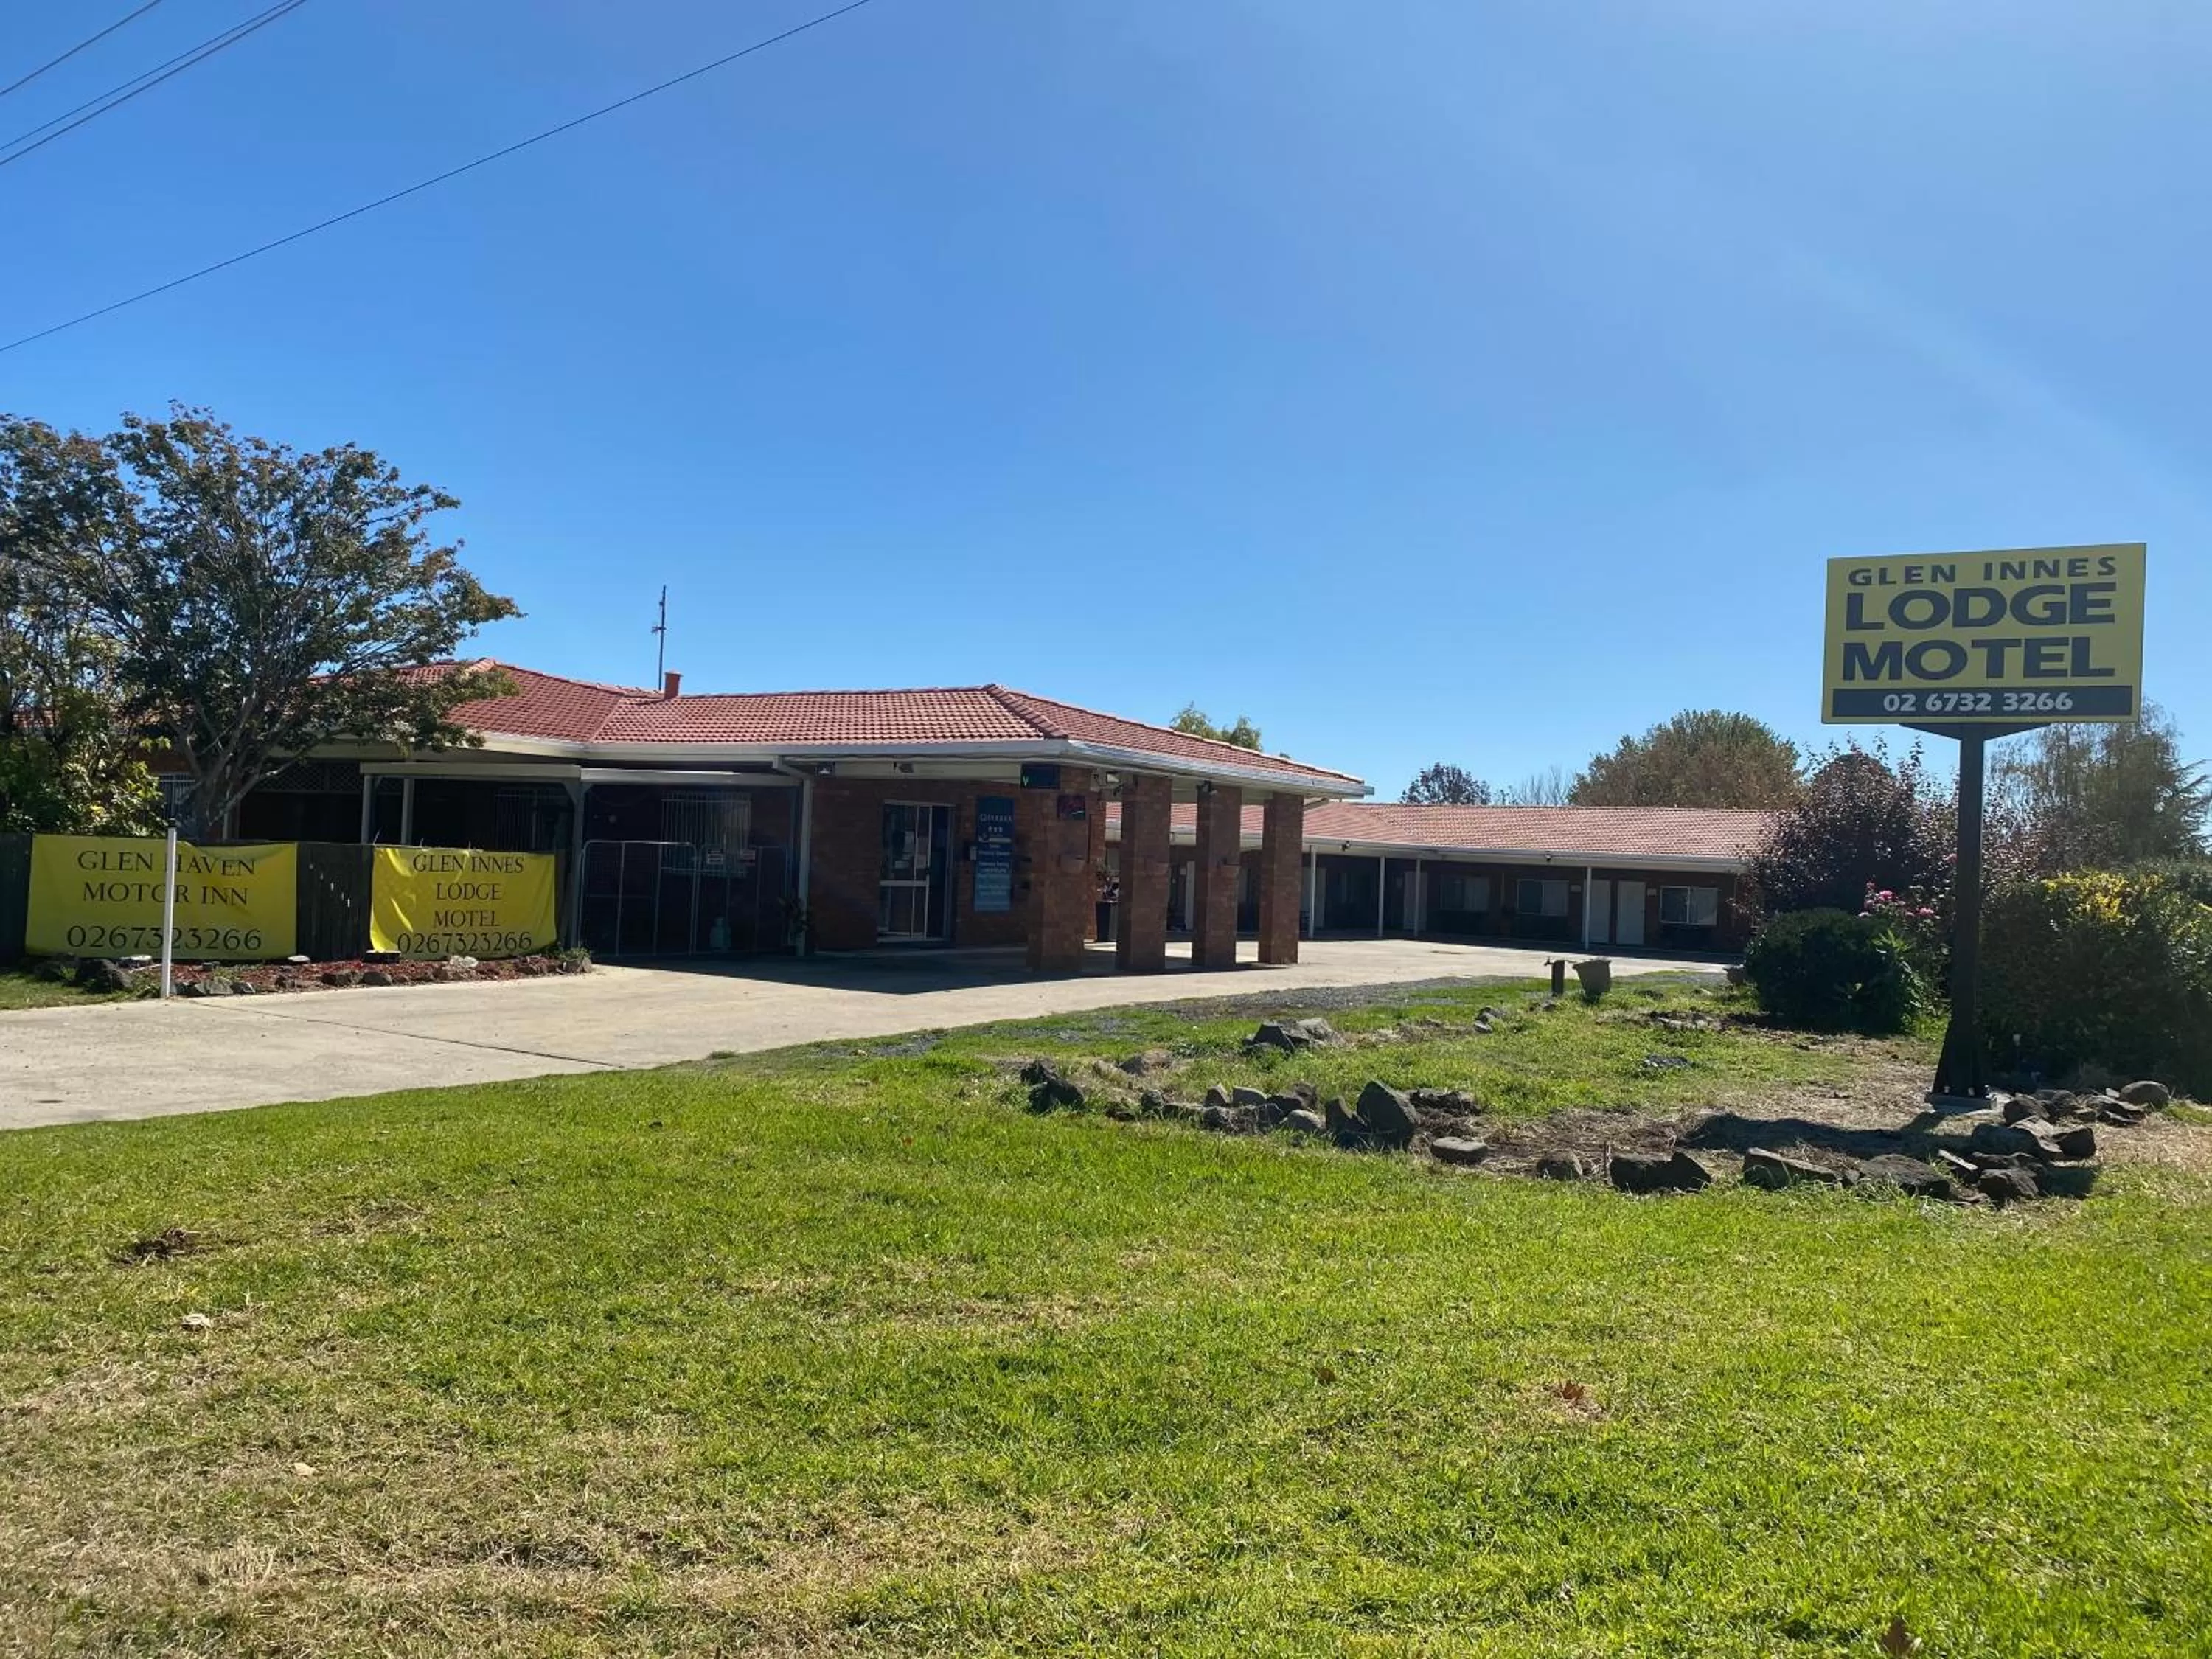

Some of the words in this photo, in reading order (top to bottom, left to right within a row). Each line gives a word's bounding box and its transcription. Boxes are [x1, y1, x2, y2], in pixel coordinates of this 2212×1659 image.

[1848, 564, 1956, 586] GLEN
[1983, 557, 2117, 580] INNES
[1846, 582, 2117, 631] LODGE
[1843, 636, 2115, 681] MOTEL
[1883, 694, 1917, 712] 02
[1925, 692, 1992, 712] 6732
[2003, 692, 2073, 711] 3266
[77, 850, 153, 872] GLEN
[413, 854, 463, 872] GLEN
[472, 856, 525, 874] INNES
[201, 885, 248, 906] INN
[436, 883, 503, 900] LODGE
[433, 910, 501, 928] MOTEL
[397, 931, 532, 953] 0267323266
